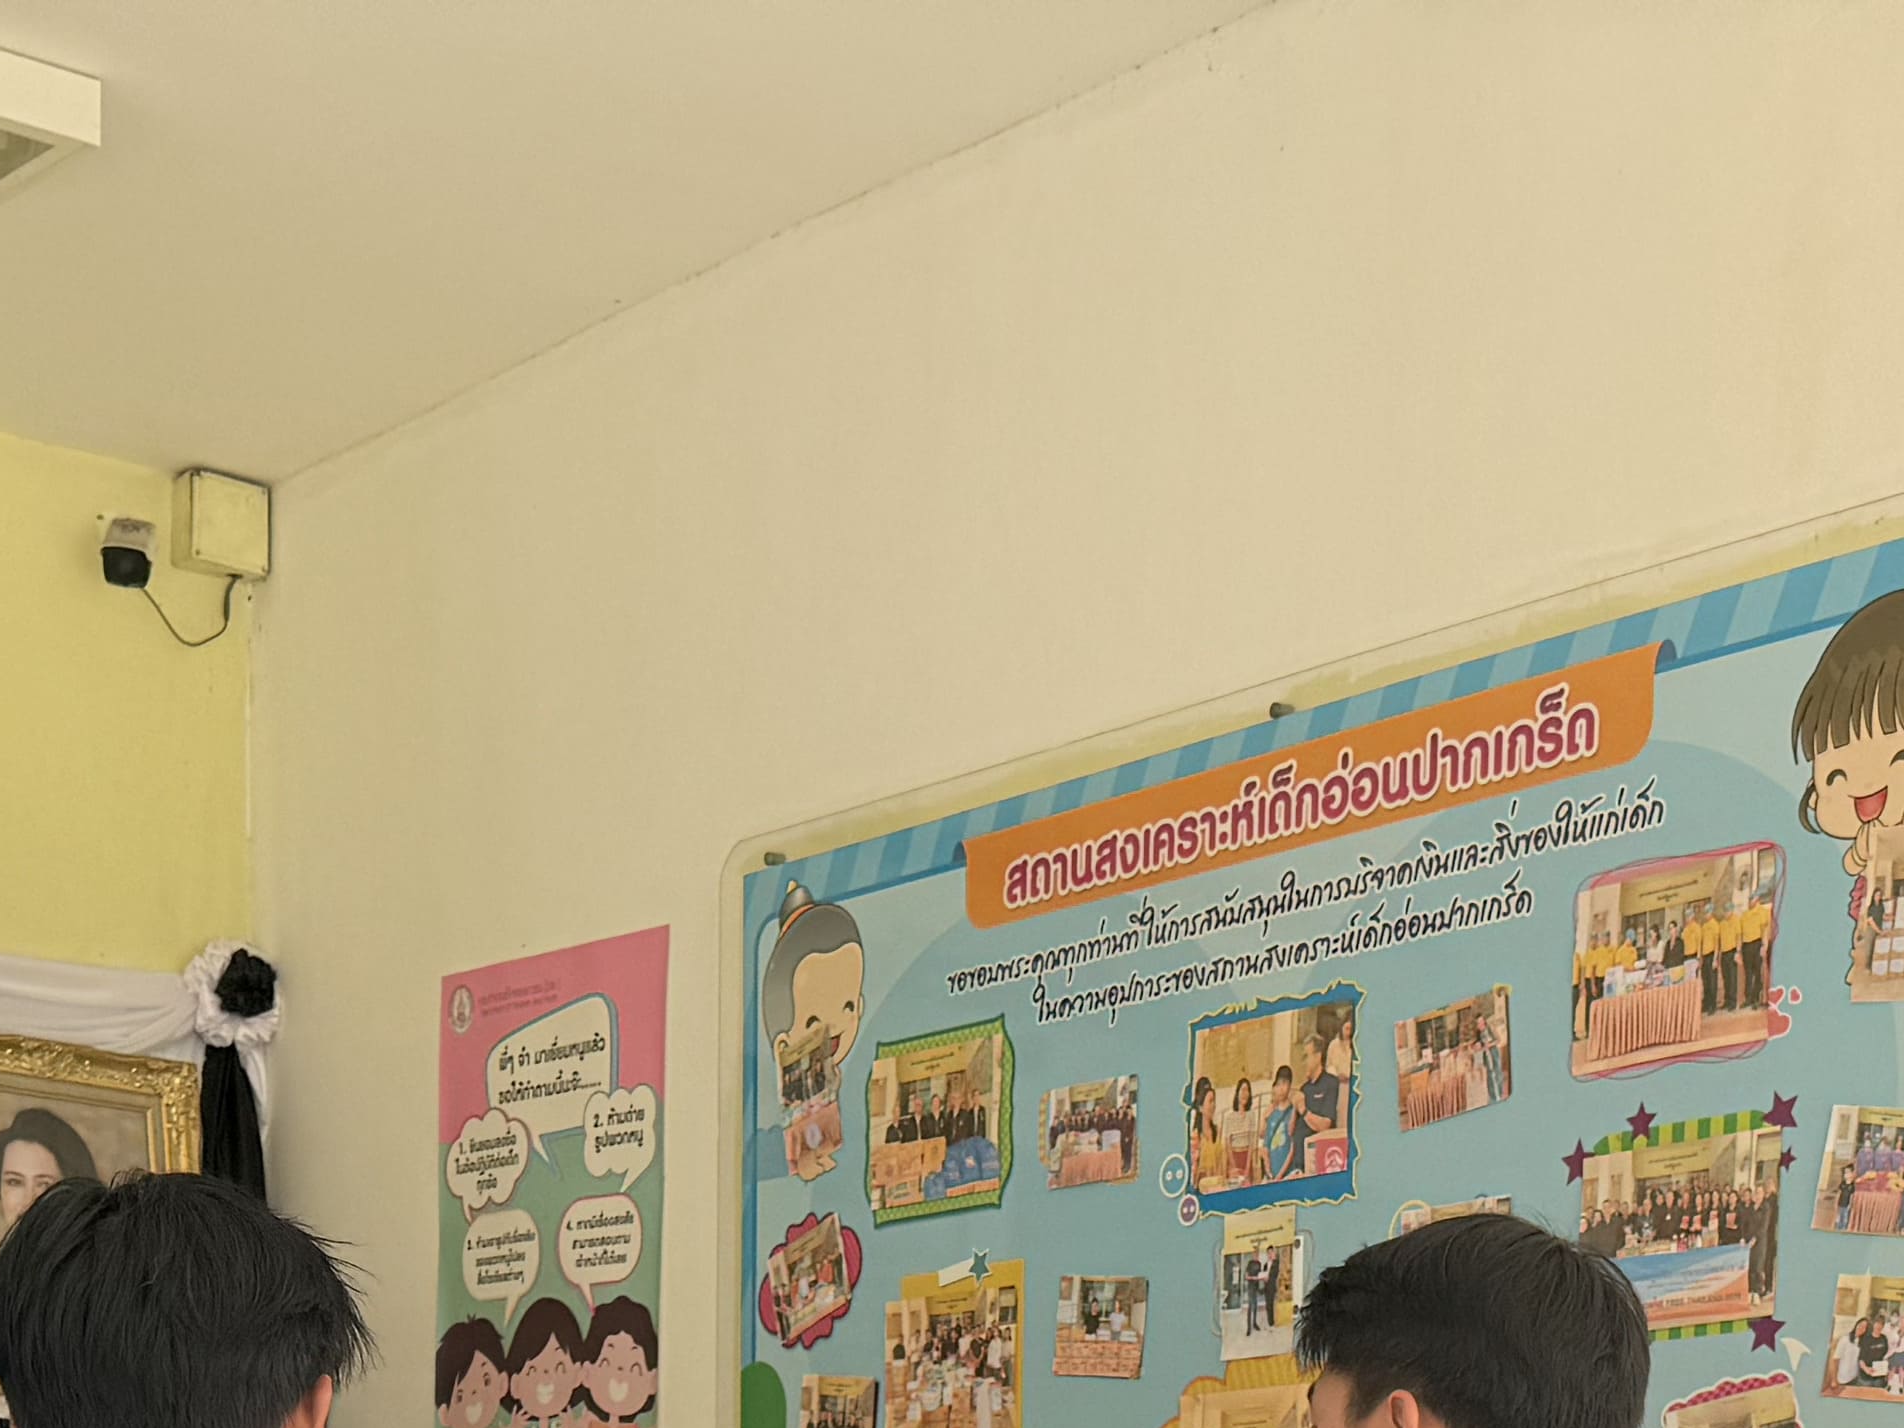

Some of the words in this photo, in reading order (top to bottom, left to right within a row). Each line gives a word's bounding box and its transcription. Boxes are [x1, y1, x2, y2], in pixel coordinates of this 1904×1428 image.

[1002, 682, 1601, 910] สถานสงเคราะห์เด็กอ่อนปากเกร็ด
